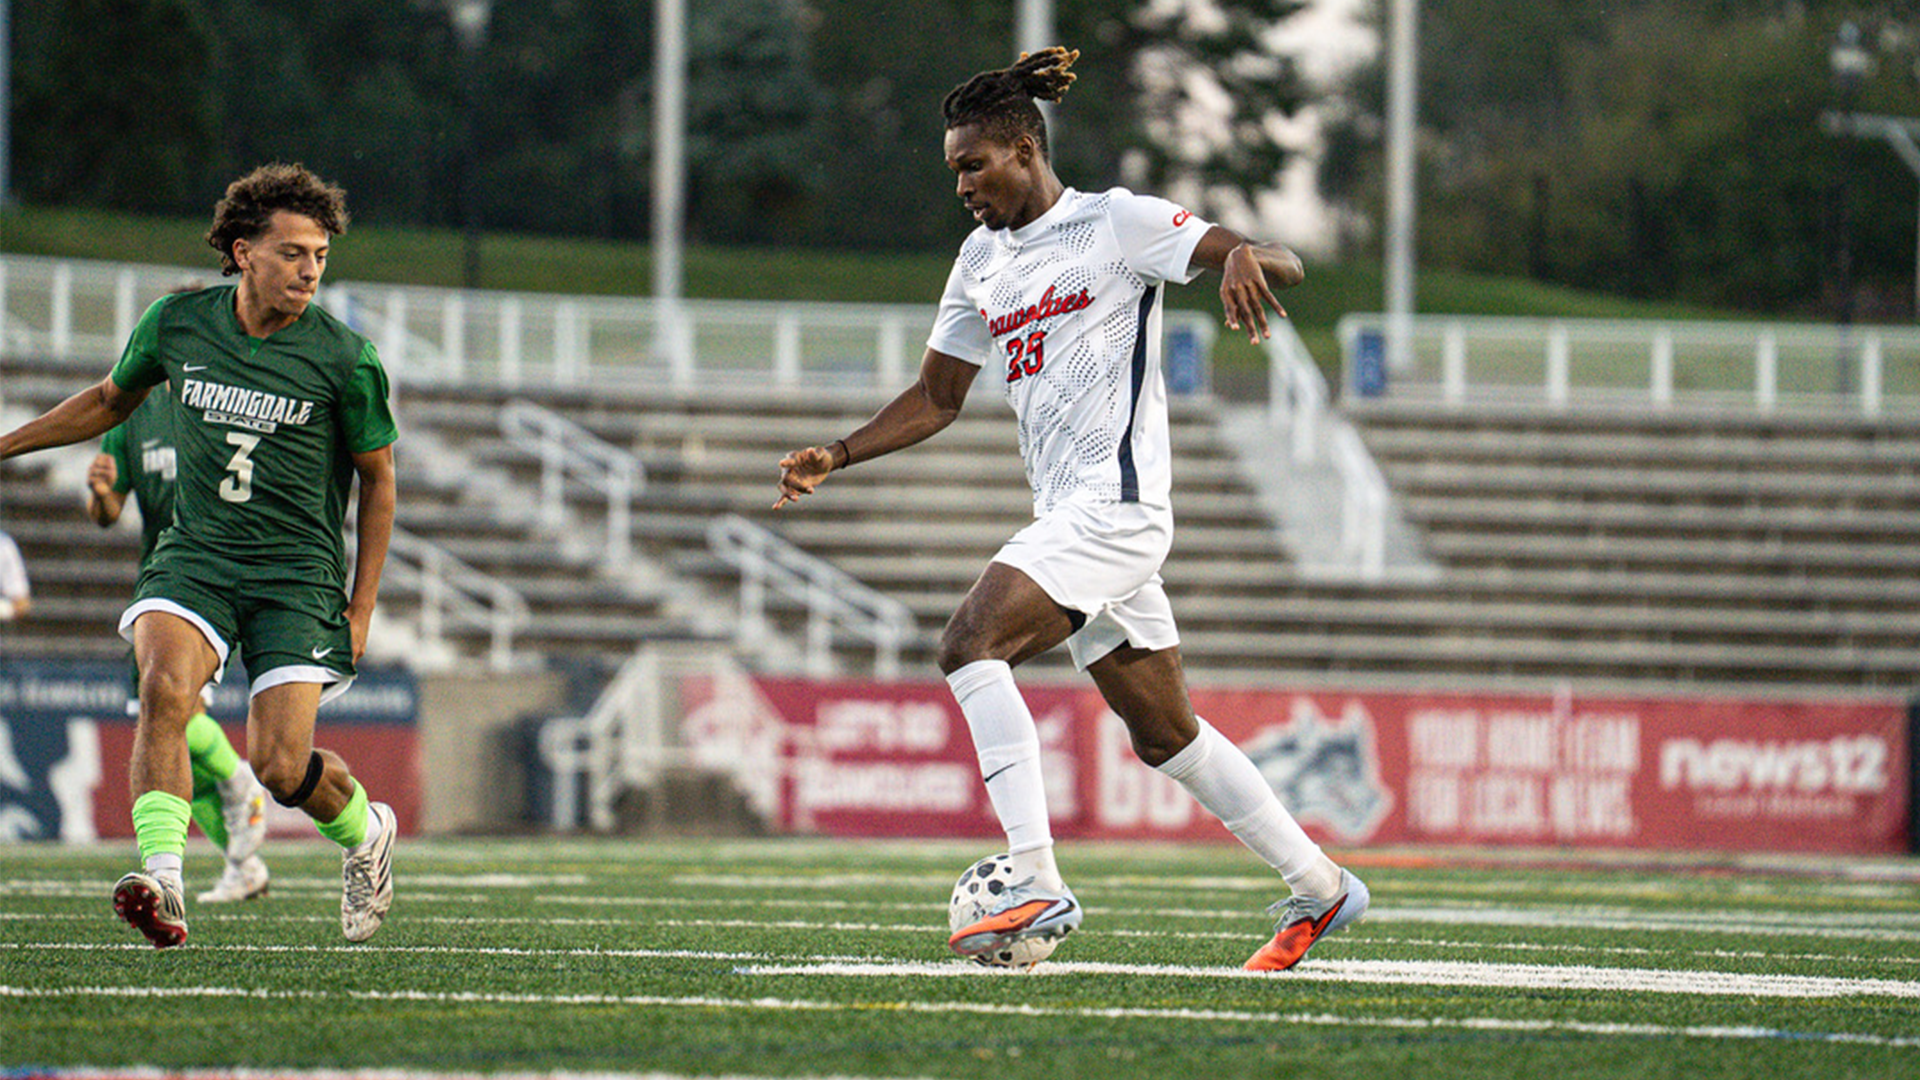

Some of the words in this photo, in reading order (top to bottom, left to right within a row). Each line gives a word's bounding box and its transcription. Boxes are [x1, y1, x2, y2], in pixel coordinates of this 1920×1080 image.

[979, 284, 1096, 338] eawolves
[1006, 331, 1048, 383] 25
[181, 378, 314, 425] FARMINGDALE
[204, 410, 277, 434] STATE
[218, 431, 263, 503] 3
[1659, 734, 1889, 792] news12
